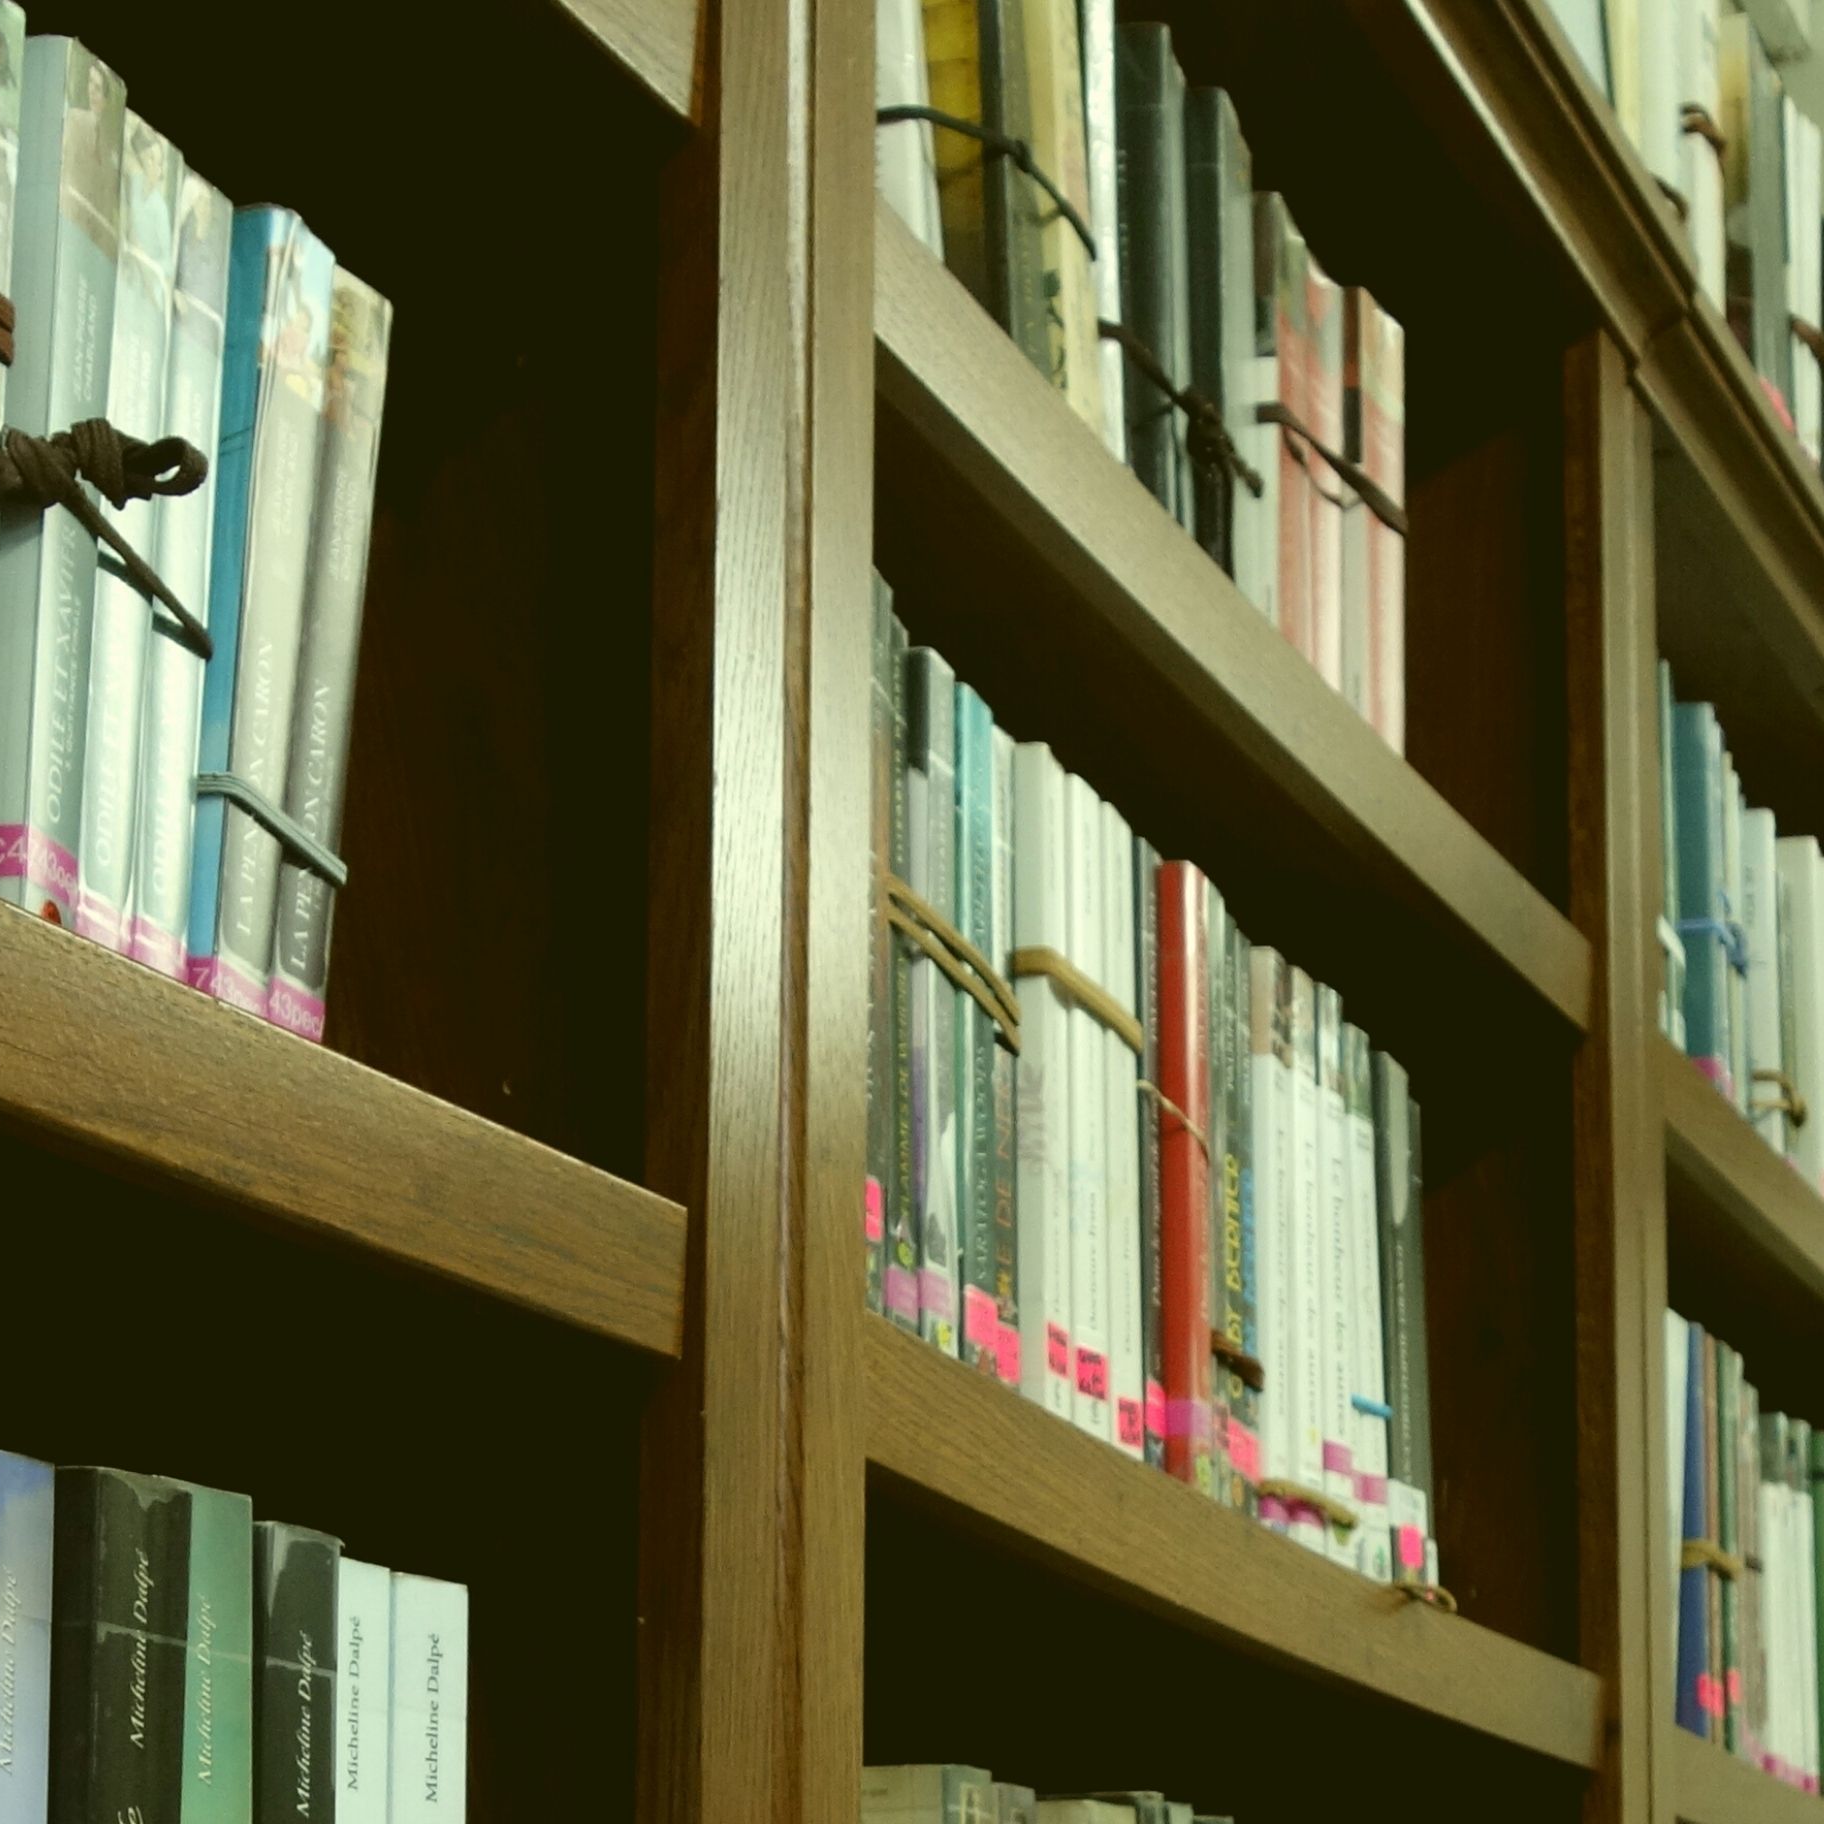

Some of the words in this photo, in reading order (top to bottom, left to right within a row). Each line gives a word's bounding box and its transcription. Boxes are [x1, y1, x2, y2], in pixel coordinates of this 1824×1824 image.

[53, 653, 70, 702] ET
[46, 707, 68, 825] ODILE
[290, 928, 308, 972] LA
[306, 677, 329, 788] CARON
[134, 1547, 152, 1627] Dalpé
[128, 1632, 149, 1750] Micheline
[296, 1630, 315, 1701] Dalpé
[348, 1614, 361, 1678] Dalpé
[427, 1632, 441, 1695] Dalpé
[196, 1666, 215, 1787] Micheline
[294, 1700, 313, 1819] Micheline
[345, 1681, 360, 1793] Micheline
[423, 1697, 440, 1804] Micheline
